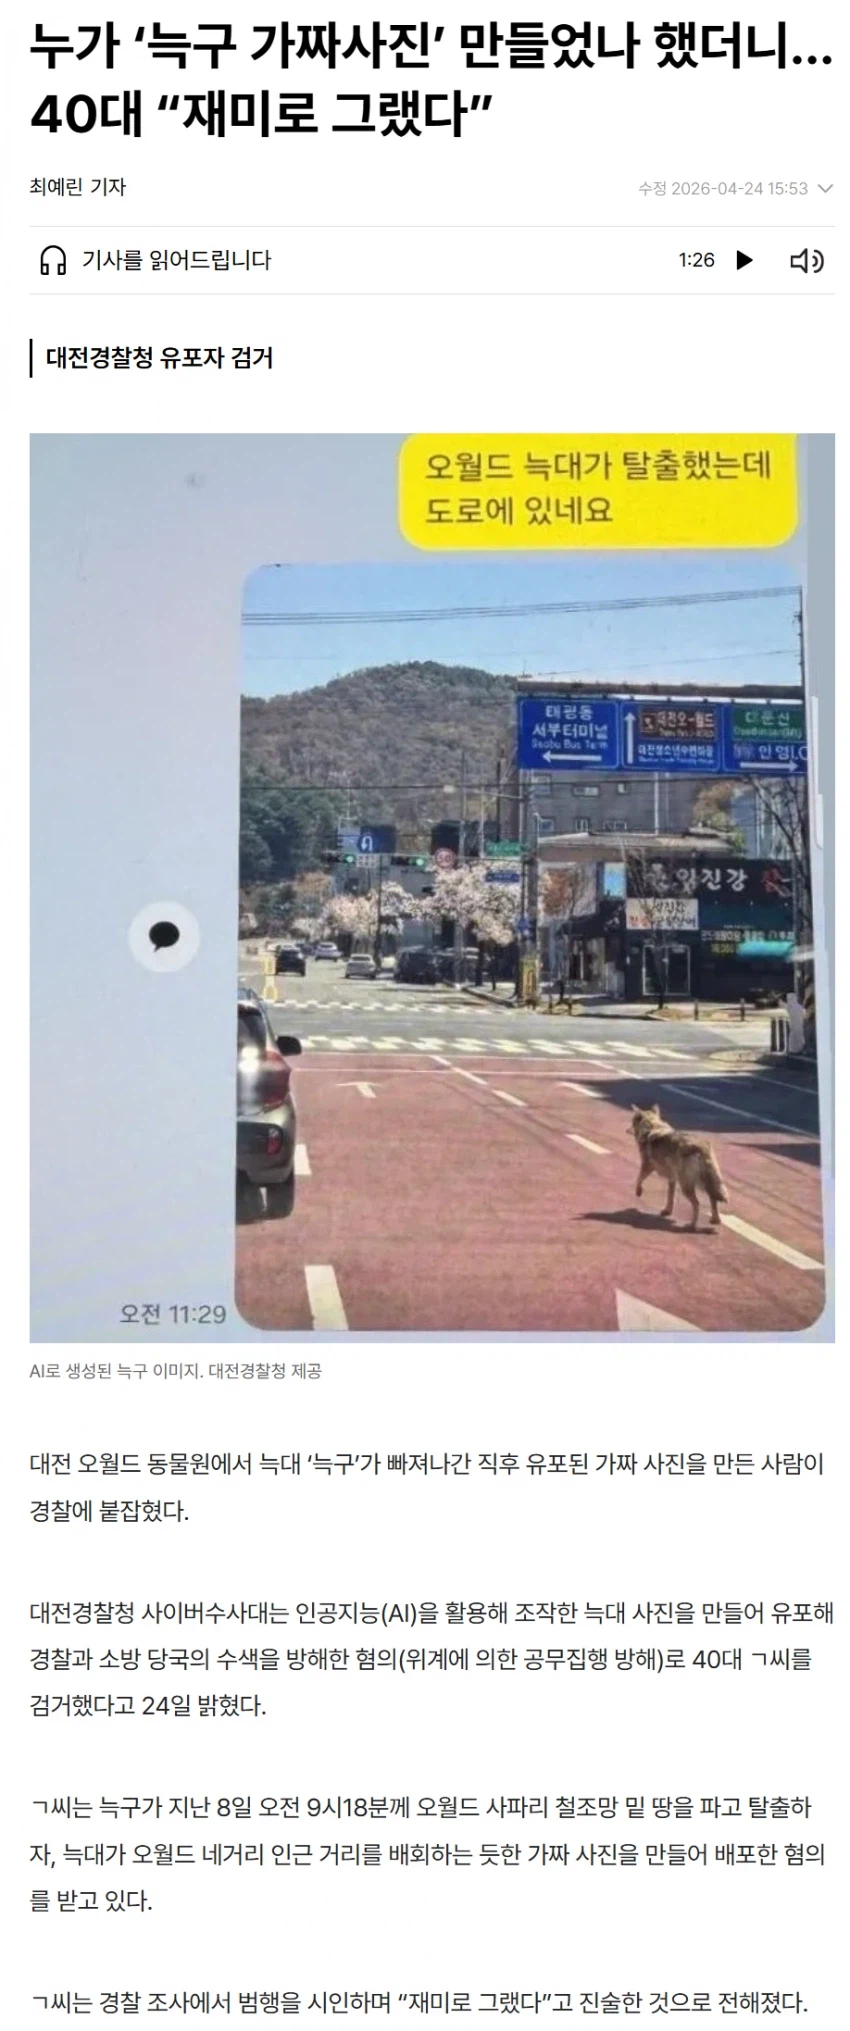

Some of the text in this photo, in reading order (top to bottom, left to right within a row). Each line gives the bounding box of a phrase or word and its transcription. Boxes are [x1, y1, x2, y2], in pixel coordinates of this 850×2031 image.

[30, 21, 121, 70] 누가
[460, 21, 641, 70] 만들었나
[30, 89, 142, 138] 40대
[29, 177, 127, 197] 최예린 기자
[638, 180, 809, 197] 수정 2026-04-24 15:53
[82, 249, 272, 271] 기사를 읽어드립니다
[679, 252, 715, 268] 1:26
[46, 345, 273, 370] 대전경찰청 유포자 검거
[425, 450, 772, 481] 오월드 늑대가 탈출했는데
[425, 496, 614, 526] 도로에 있네요
[532, 722, 608, 740] 서부터미널
[563, 739, 582, 749] Bus
[119, 1303, 227, 1326] 오전 11:29
[29, 1362, 322, 1380] AI로 생성된 늑구 이미지. 대전경찰청 제공
[30, 1452, 71, 1476] 대전
[77, 1452, 142, 1476] 오월드
[147, 1452, 251, 1476] 동물원에서
[259, 1452, 301, 1476] 늑대
[387, 1452, 472, 1476] 빠져나간
[478, 1452, 520, 1476] 직후
[525, 1452, 588, 1476] 유포된
[595, 1452, 638, 1476] 가짜
[643, 1452, 707, 1476] 사진을
[713, 1452, 755, 1476] 만든
[761, 1452, 823, 1476] 사람이
[30, 1499, 189, 1523] 경찰에 붙잡혔다.
[30, 1601, 834, 1628] 대전경찰청 사이버수사대는 인공지능(AI)을 활용해 조작한 늑대 사진을 만들어 유포해
[30, 1647, 94, 1671] 경찰과
[99, 1647, 142, 1671] 소방
[148, 1647, 209, 1671] 당국의
[216, 1648, 281, 1671] 수색을
[286, 1647, 350, 1671] 방해한
[355, 1647, 469, 1674] 혐의(위계에
[475, 1647, 519, 1671] 의한
[523, 1647, 608, 1671] 공무집행
[615, 1647, 686, 1674] 방해)로
[692, 1647, 742, 1671] 40대
[30, 1693, 266, 1717] 검거했다고 24일 밝혔다.
[99, 1796, 163, 1819] 늑구가
[168, 1795, 211, 1819] 지난
[216, 1795, 252, 1819] 8일
[258, 1796, 300, 1819] 오전
[307, 1795, 410, 1819] 9시18분께
[416, 1796, 480, 1819] 오월드
[486, 1795, 548, 1819] 사파리
[555, 1795, 619, 1819] 철조망
[625, 1795, 645, 1819] 밑
[652, 1796, 694, 1819] 땅을
[699, 1796, 743, 1819] 파고
[748, 1795, 813, 1819] 탈출하
[29, 1842, 824, 1869] 자, 늑대가 오월드 네거리 인근 거리를 배회하는 듯한 가짜 사진을 만들어 배포한 혐의
[29, 1889, 153, 1913] 를 받고 있다.
[99, 1991, 142, 2015] 경찰
[147, 1991, 231, 2015] 조사에서
[238, 1991, 302, 2015] 범행을
[307, 1991, 390, 2015] 시인하며
[579, 1991, 643, 2014] 진술한
[649, 1991, 712, 2014] 것으로
[718, 1991, 808, 2015] 전해졌다.
